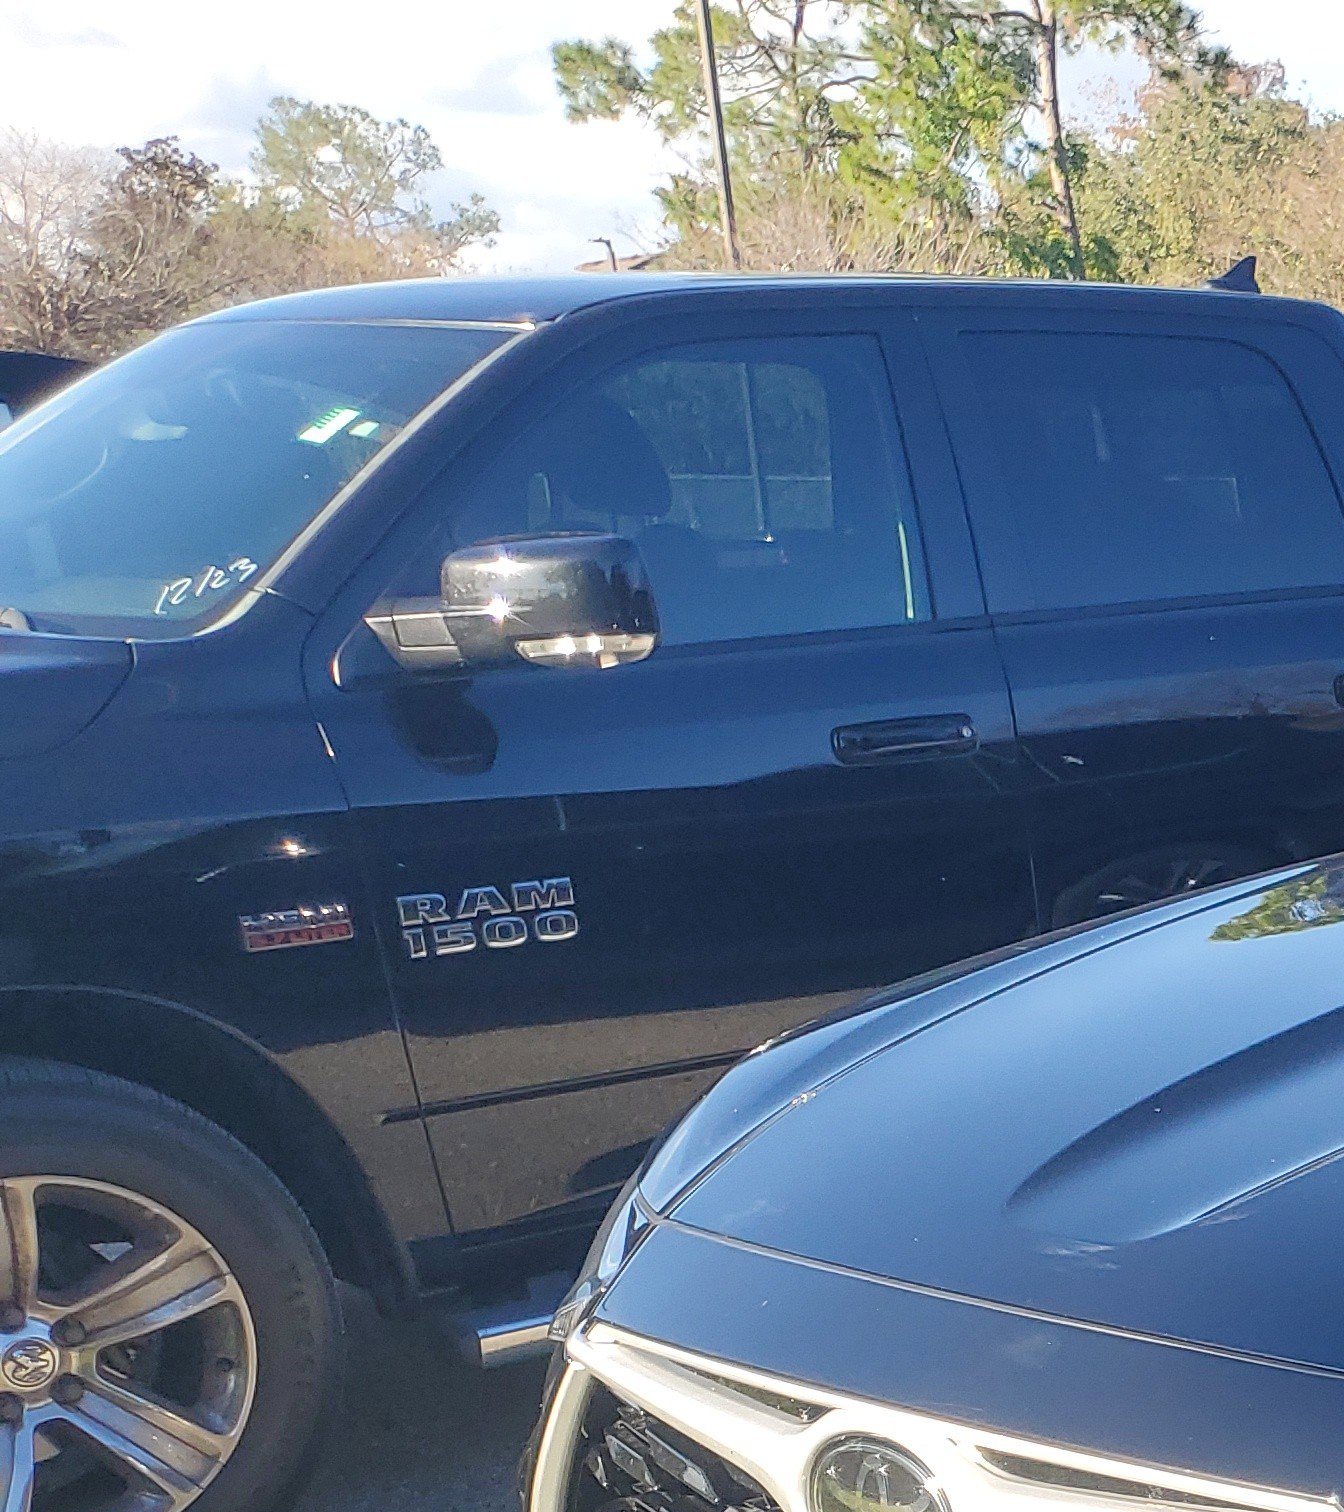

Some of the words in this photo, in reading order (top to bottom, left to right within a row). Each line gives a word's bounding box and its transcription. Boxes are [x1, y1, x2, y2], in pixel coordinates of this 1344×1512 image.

[154, 557, 258, 615] 12/23
[397, 876, 575, 927] RAM
[401, 909, 579, 959] 1500
